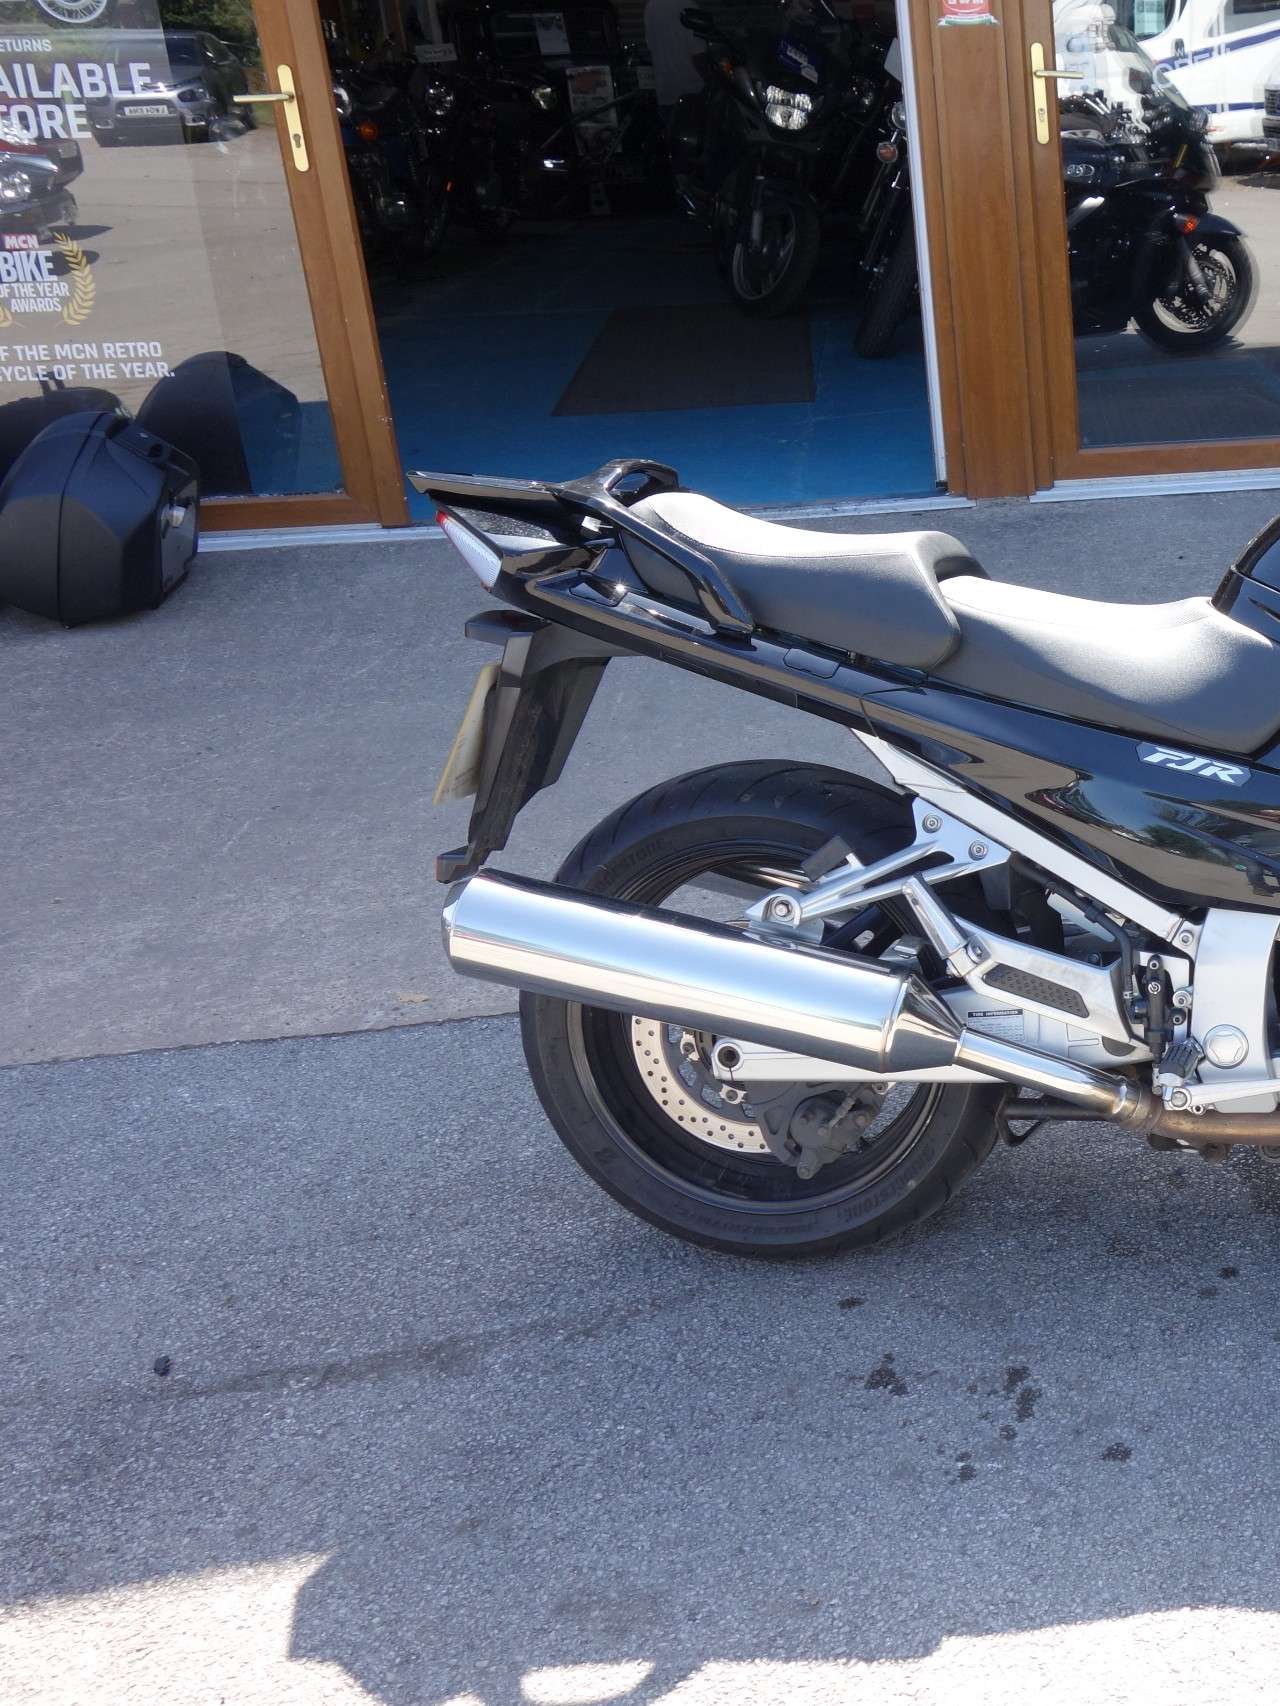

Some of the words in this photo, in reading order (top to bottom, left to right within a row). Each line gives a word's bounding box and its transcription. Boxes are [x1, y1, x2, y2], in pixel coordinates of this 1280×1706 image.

[5, 235, 39, 249] MCN
[0, 250, 58, 282] BIKE
[11, 283, 37, 298] THE
[36, 281, 70, 297] YEAR
[11, 297, 62, 313] AWARDS
[12, 344, 50, 361] THE
[55, 342, 98, 360] MCN
[102, 341, 162, 358] RETRO
[53, 363, 77, 381] OF
[80, 362, 117, 379] THE
[119, 360, 176, 379] YEAR.
[1143, 747, 1244, 783] FJR
